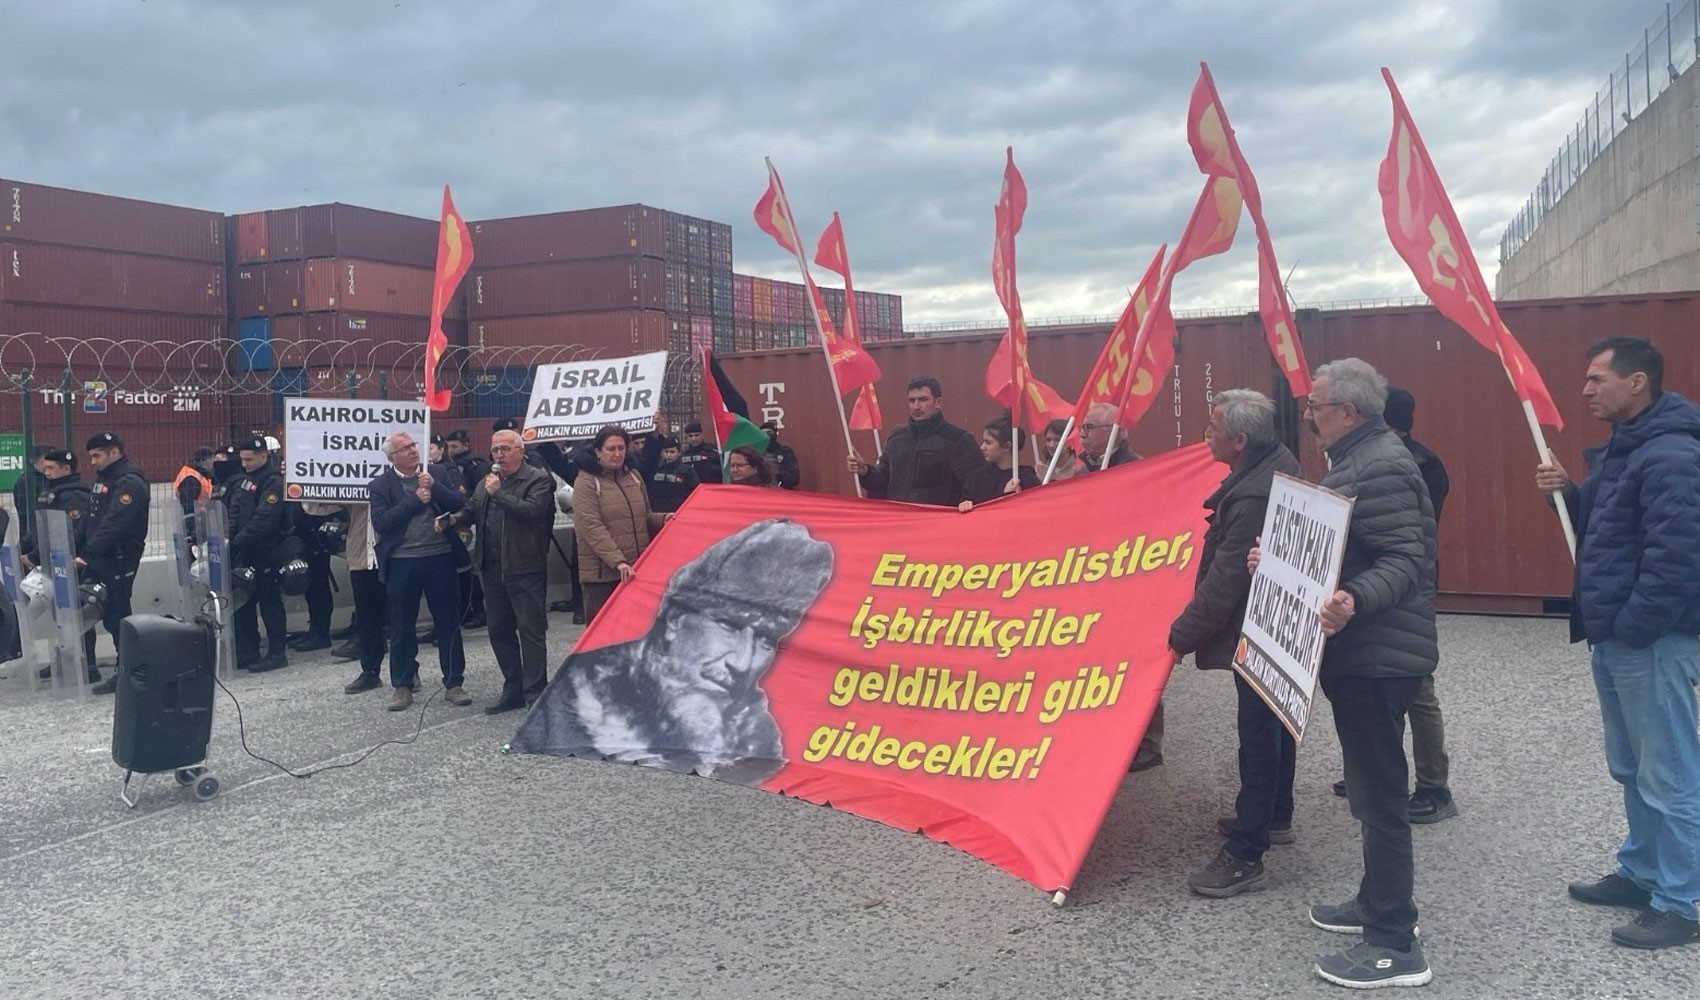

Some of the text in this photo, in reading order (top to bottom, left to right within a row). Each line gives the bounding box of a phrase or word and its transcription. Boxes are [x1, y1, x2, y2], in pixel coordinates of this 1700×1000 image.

[551, 361, 645, 390] İSRAİL
[1205, 363, 1213, 416] 22G1
[114, 389, 168, 404] Factor
[532, 387, 652, 419] ABD'DİR
[290, 406, 426, 424] KAHROLSUN
[322, 431, 387, 451] İSRAİ
[537, 425, 570, 438] HALKIN
[0, 455, 24, 470] EN
[303, 485, 371, 499] HALKIN KURTU
[871, 531, 1194, 598] Emperyalistler,
[1249, 570, 1283, 638] YALNIZ
[849, 596, 1102, 658] İşbirlikçiler
[829, 661, 1128, 724] geldikleri gibi
[802, 721, 1053, 780] gidecekler!
